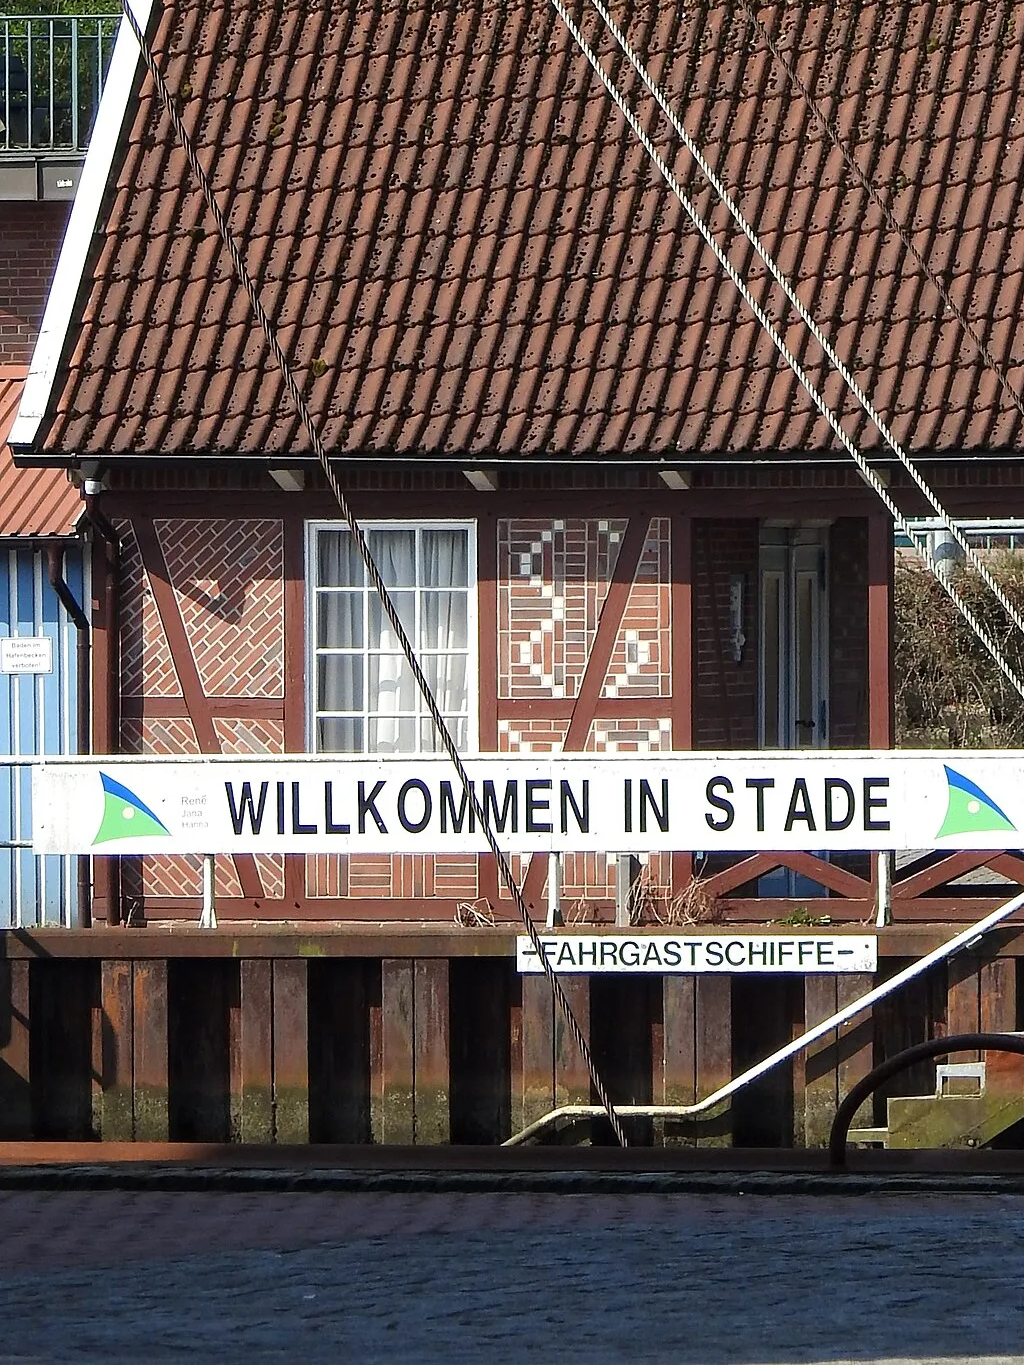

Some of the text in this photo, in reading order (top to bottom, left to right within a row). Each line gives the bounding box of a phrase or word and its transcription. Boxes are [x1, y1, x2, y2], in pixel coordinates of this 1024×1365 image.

[224, 775, 891, 835] WILLKOMMEN IN STADE
